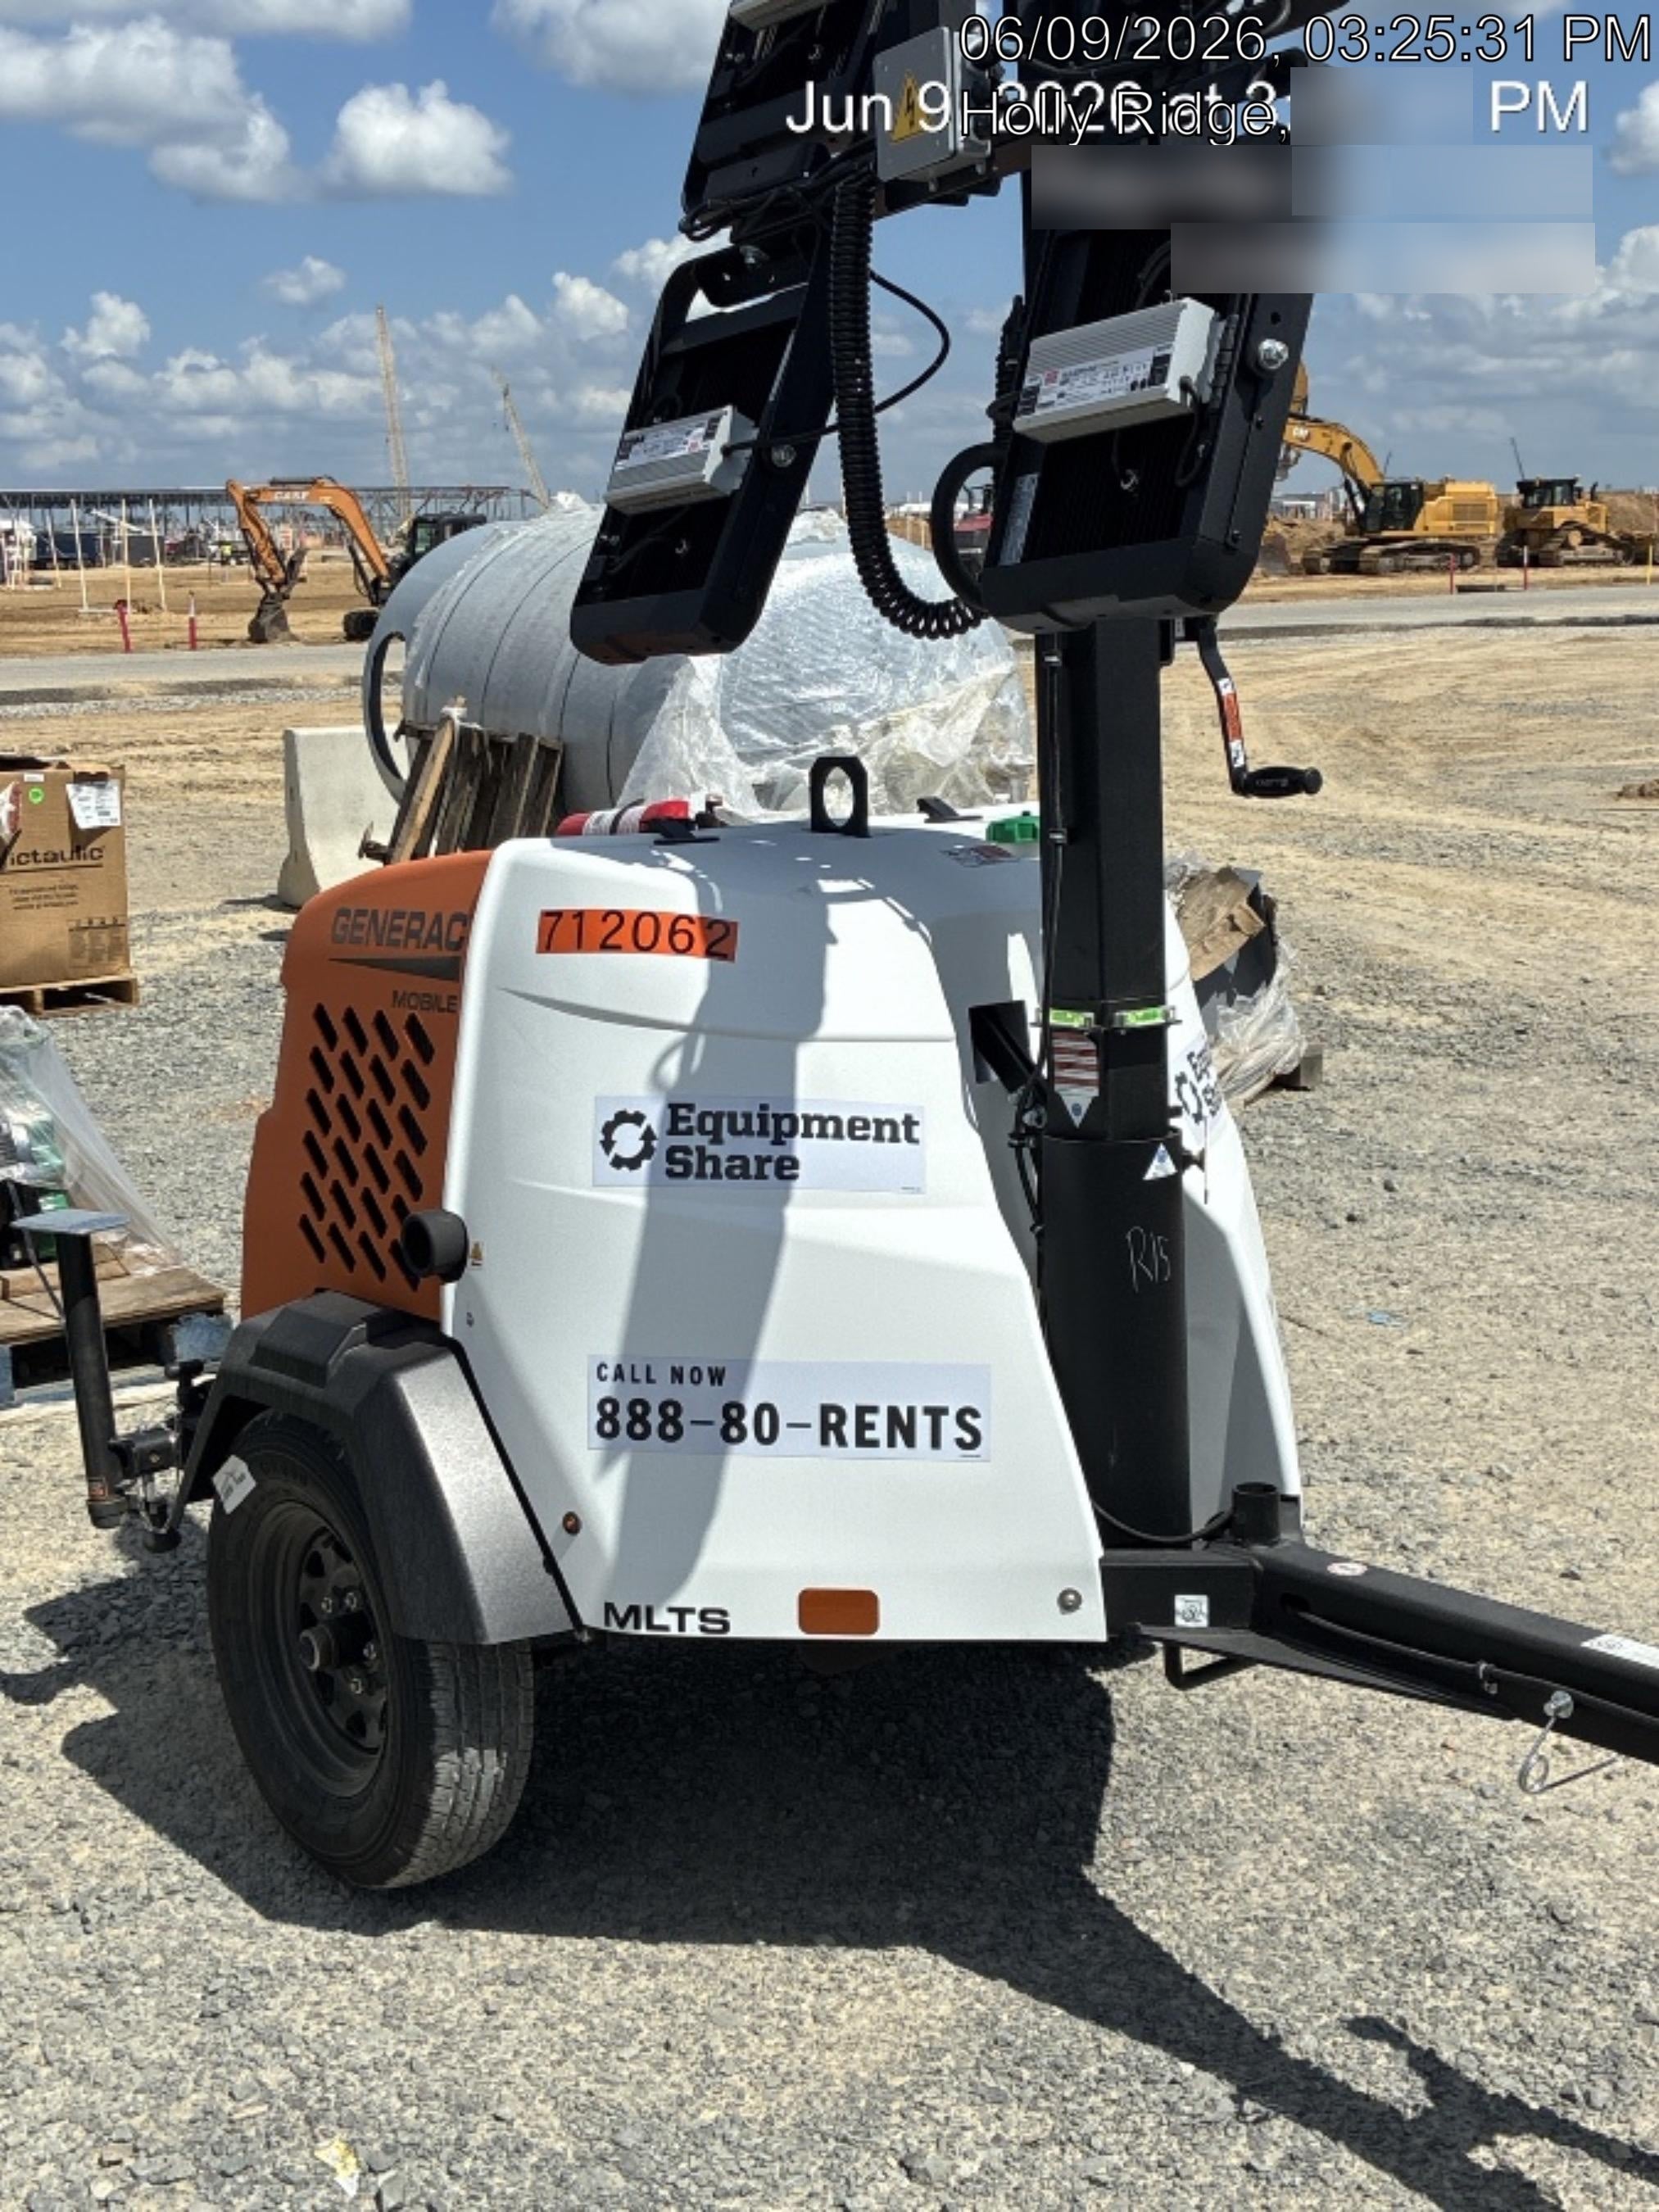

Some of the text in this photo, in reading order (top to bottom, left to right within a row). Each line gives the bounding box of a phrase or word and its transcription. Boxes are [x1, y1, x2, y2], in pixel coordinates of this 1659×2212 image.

[10, 845, 104, 866] ictaulic
[331, 907, 468, 952] GENERAC
[544, 909, 732, 958] 712062
[392, 989, 458, 1013] MOBILE
[665, 1102, 920, 1145] Equipment
[665, 1145, 800, 1181] Share
[596, 1362, 727, 1387] CALL NOW
[596, 1395, 982, 1451] 888-80-RENTS
[603, 1601, 732, 1635] MLTS
